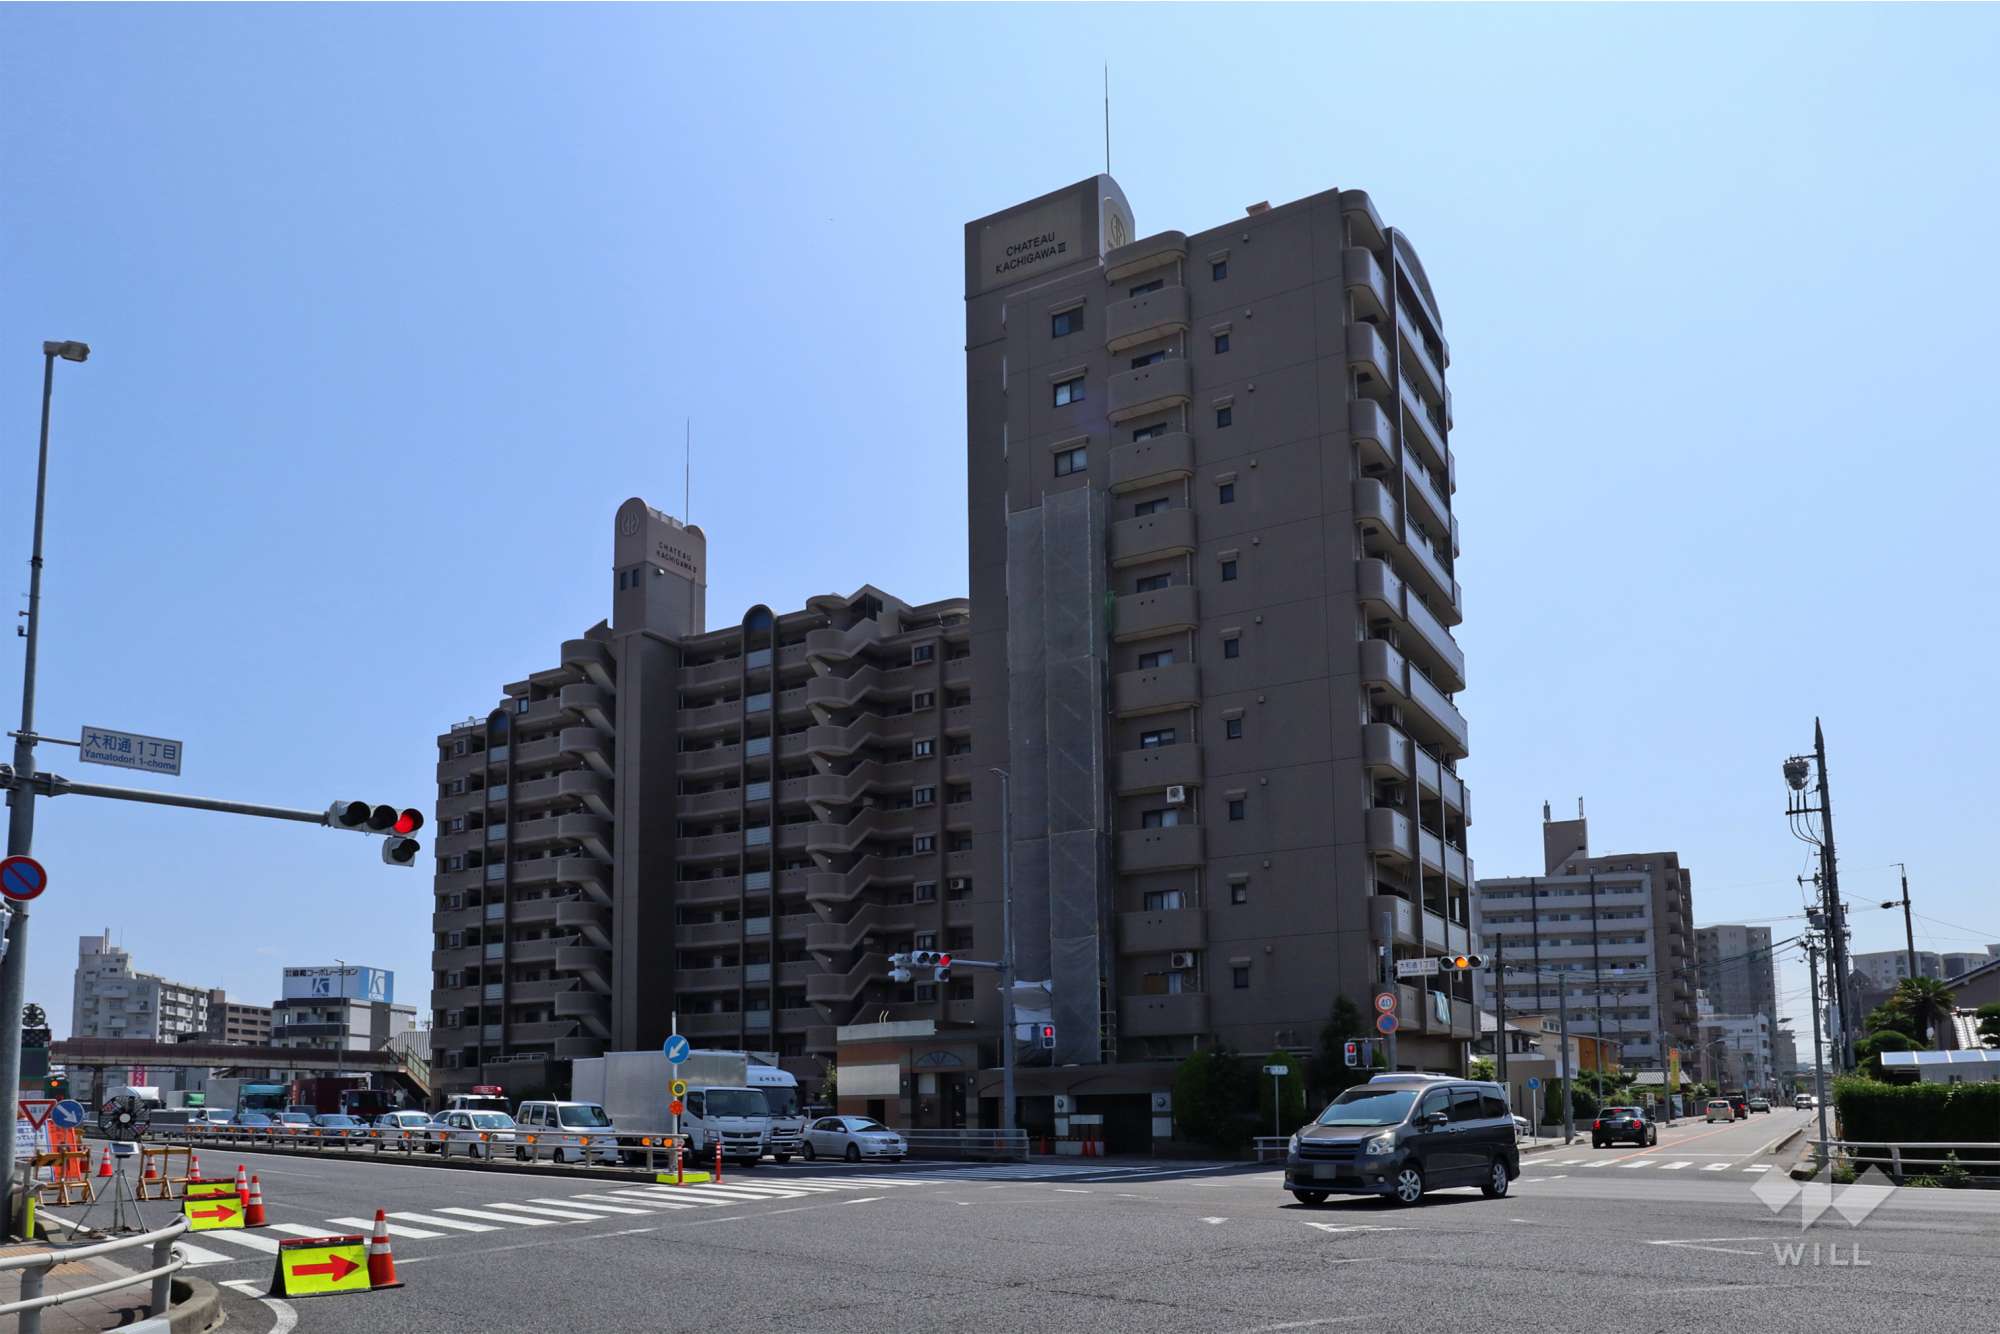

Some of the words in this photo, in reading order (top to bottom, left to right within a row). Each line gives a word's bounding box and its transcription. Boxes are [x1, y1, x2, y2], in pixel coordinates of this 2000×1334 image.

[1006, 231, 1055, 257] CHATEAU
[658, 541, 691, 561] CHATEAU
[84, 749, 135, 765] Yamatodori
[139, 757, 177, 770] 1-chome
[1381, 998, 1391, 1007] 40
